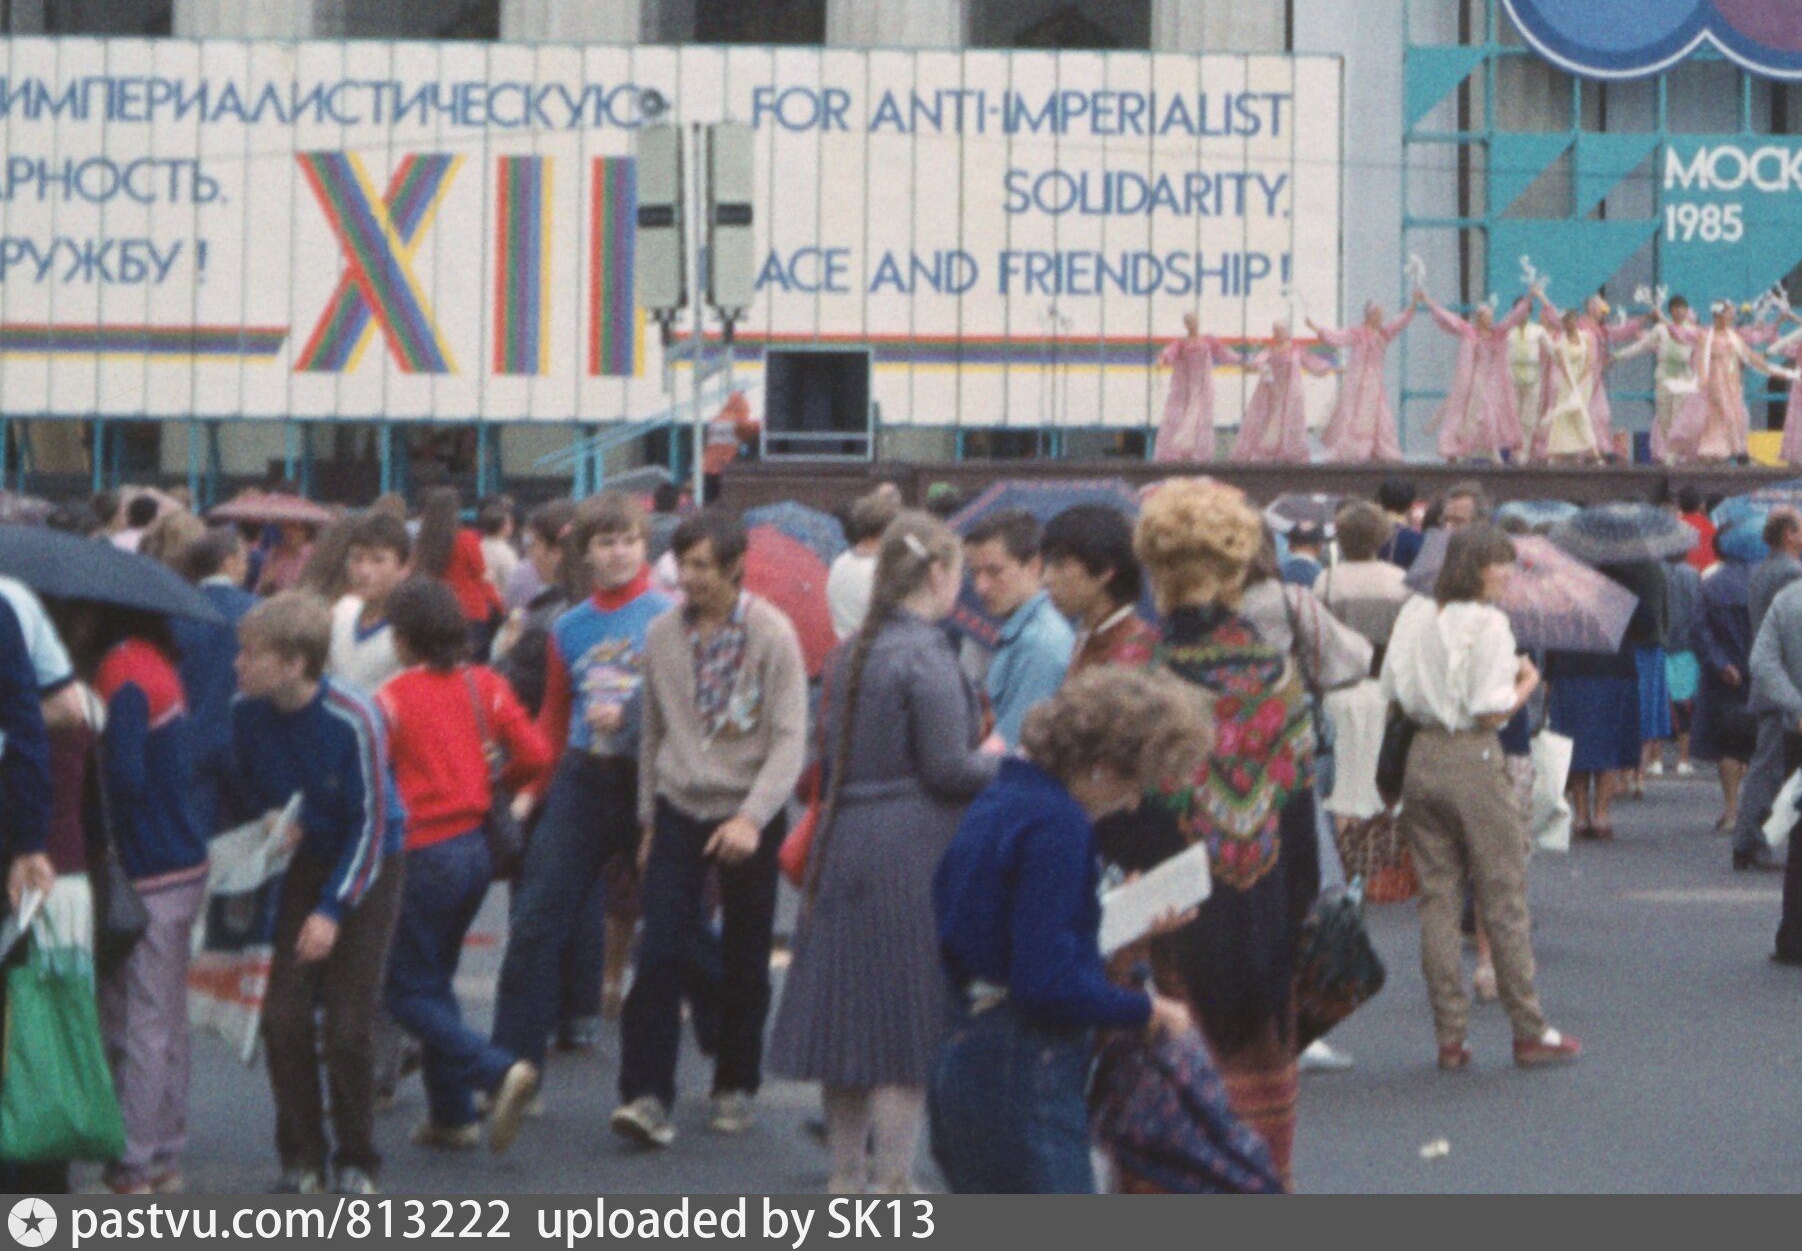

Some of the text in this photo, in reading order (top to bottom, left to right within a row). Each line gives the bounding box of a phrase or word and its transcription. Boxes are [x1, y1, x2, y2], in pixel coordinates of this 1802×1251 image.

[751, 87, 1290, 138] FOR ANTI-IMPERIALIST
[0, 156, 229, 205] РНОСТЬ.
[1002, 169, 1290, 218] SOLIDARITY.
[1665, 203, 1744, 243] 1985
[870, 248, 979, 295] AND
[999, 250, 1291, 298] FRIENDSHIP!
